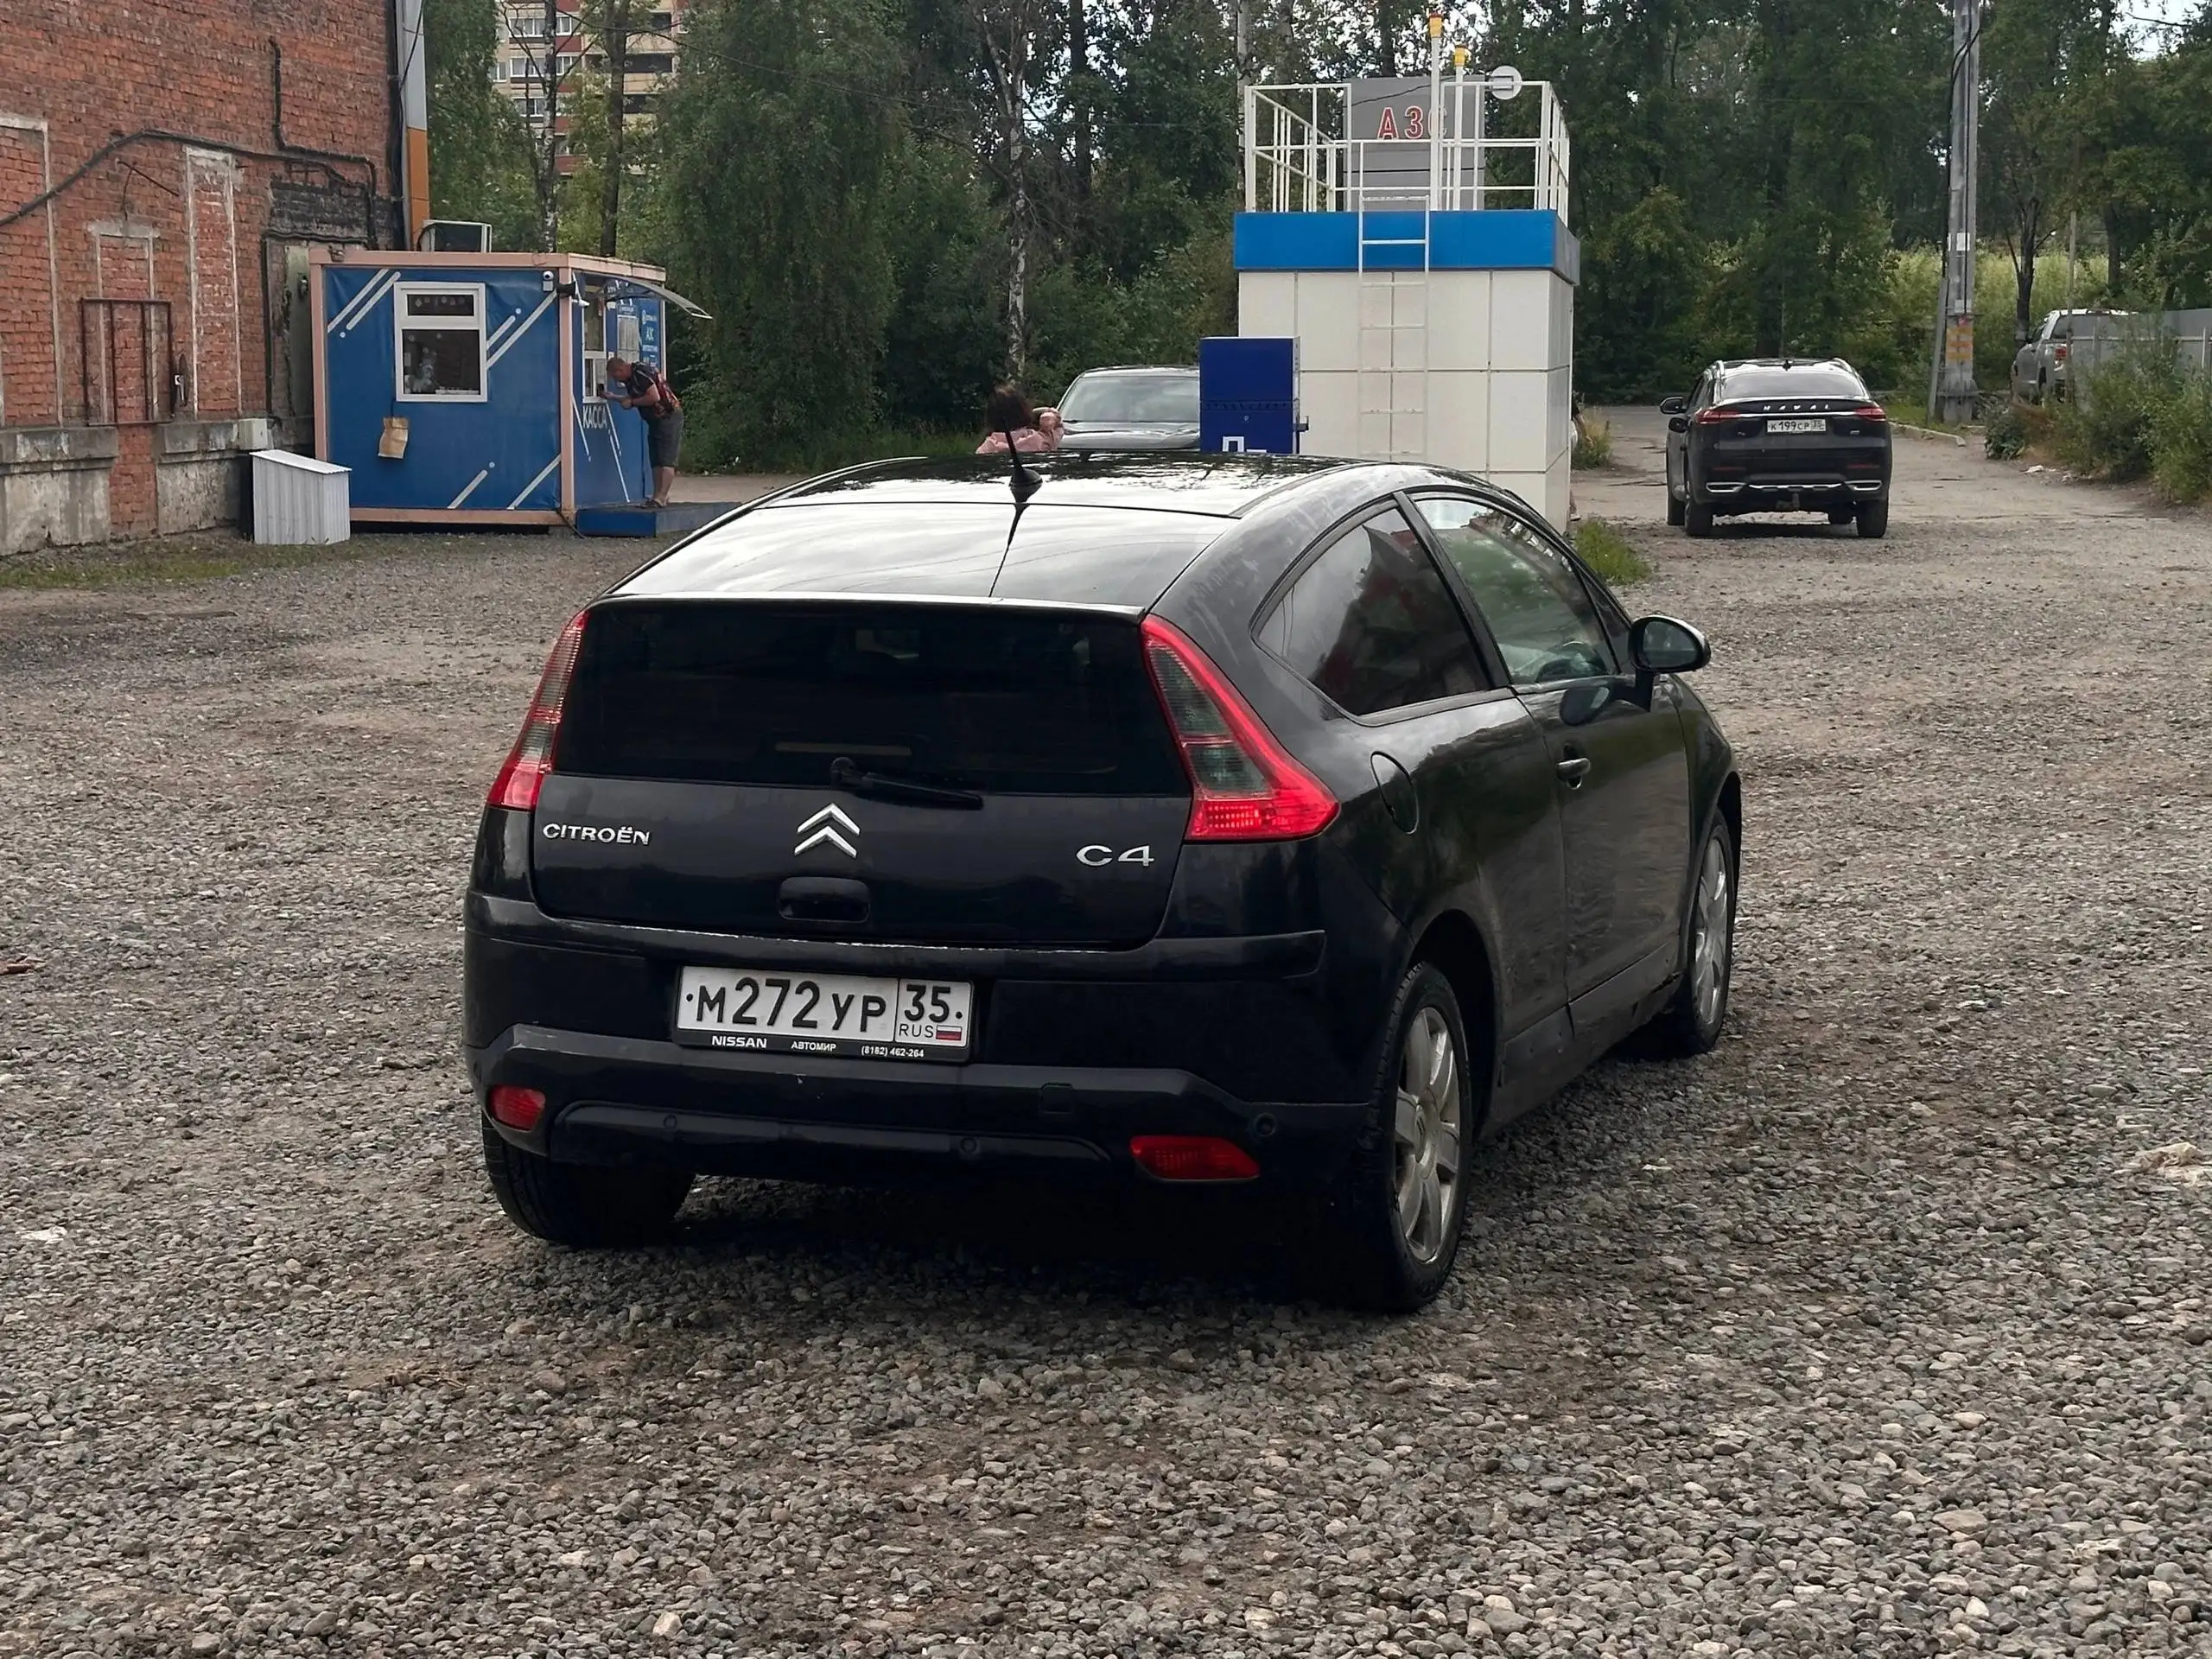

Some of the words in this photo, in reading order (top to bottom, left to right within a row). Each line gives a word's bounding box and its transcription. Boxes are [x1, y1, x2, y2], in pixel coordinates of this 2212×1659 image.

[582, 404, 607, 429] КАССА
[543, 823, 650, 845] CITROËN
[1076, 845, 1154, 867] C4
[696, 976, 887, 1033] М272УР
[904, 985, 951, 1023] 35
[899, 1023, 934, 1038] RUS
[711, 1034, 767, 1048] NISSAN
[791, 1040, 836, 1052] АВТОМИР
[861, 1046, 888, 1058] (8182)
[889, 1046, 925, 1058] 462-264
